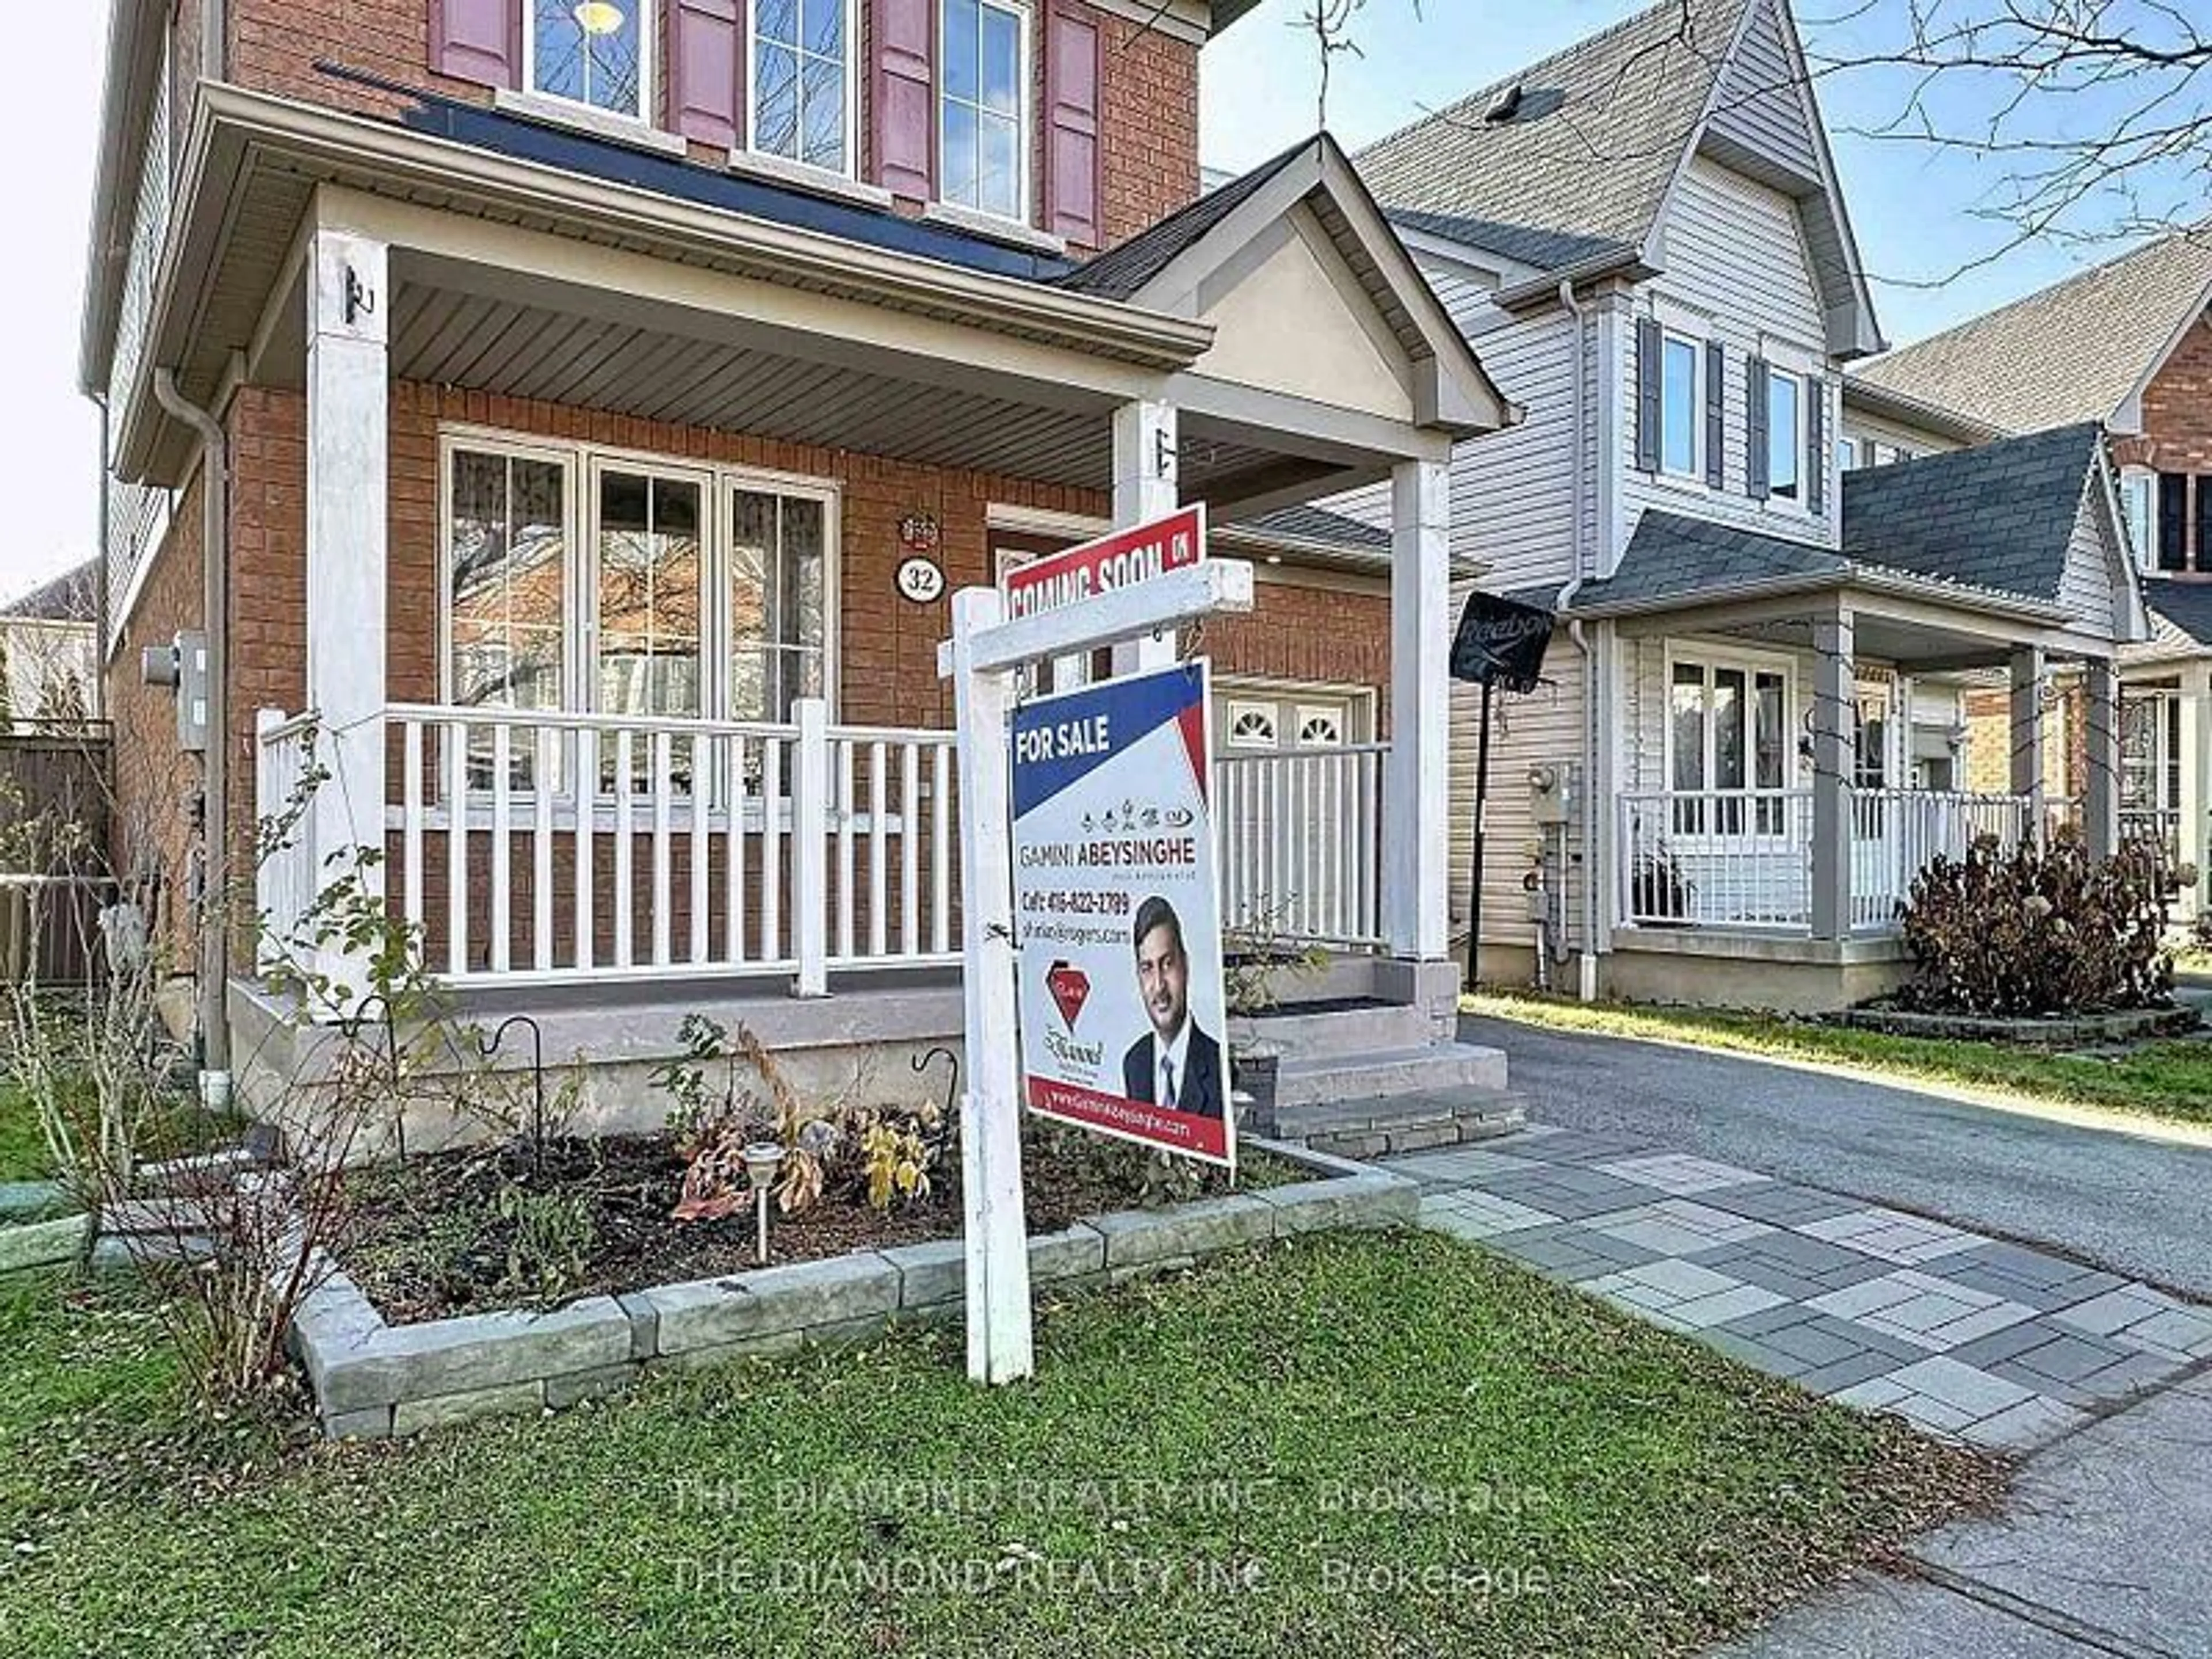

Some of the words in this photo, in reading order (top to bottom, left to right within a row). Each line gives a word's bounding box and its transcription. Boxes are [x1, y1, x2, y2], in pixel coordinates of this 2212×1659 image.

[908, 567, 933, 592] 32
[1012, 565, 1090, 622] COMING
[1099, 541, 1162, 593] SOON
[1016, 727, 1054, 764] FOR
[1058, 715, 1109, 758] SALE
[1020, 845, 1074, 868] GAMINI
[1077, 838, 1195, 866] ABEYSINGHE
